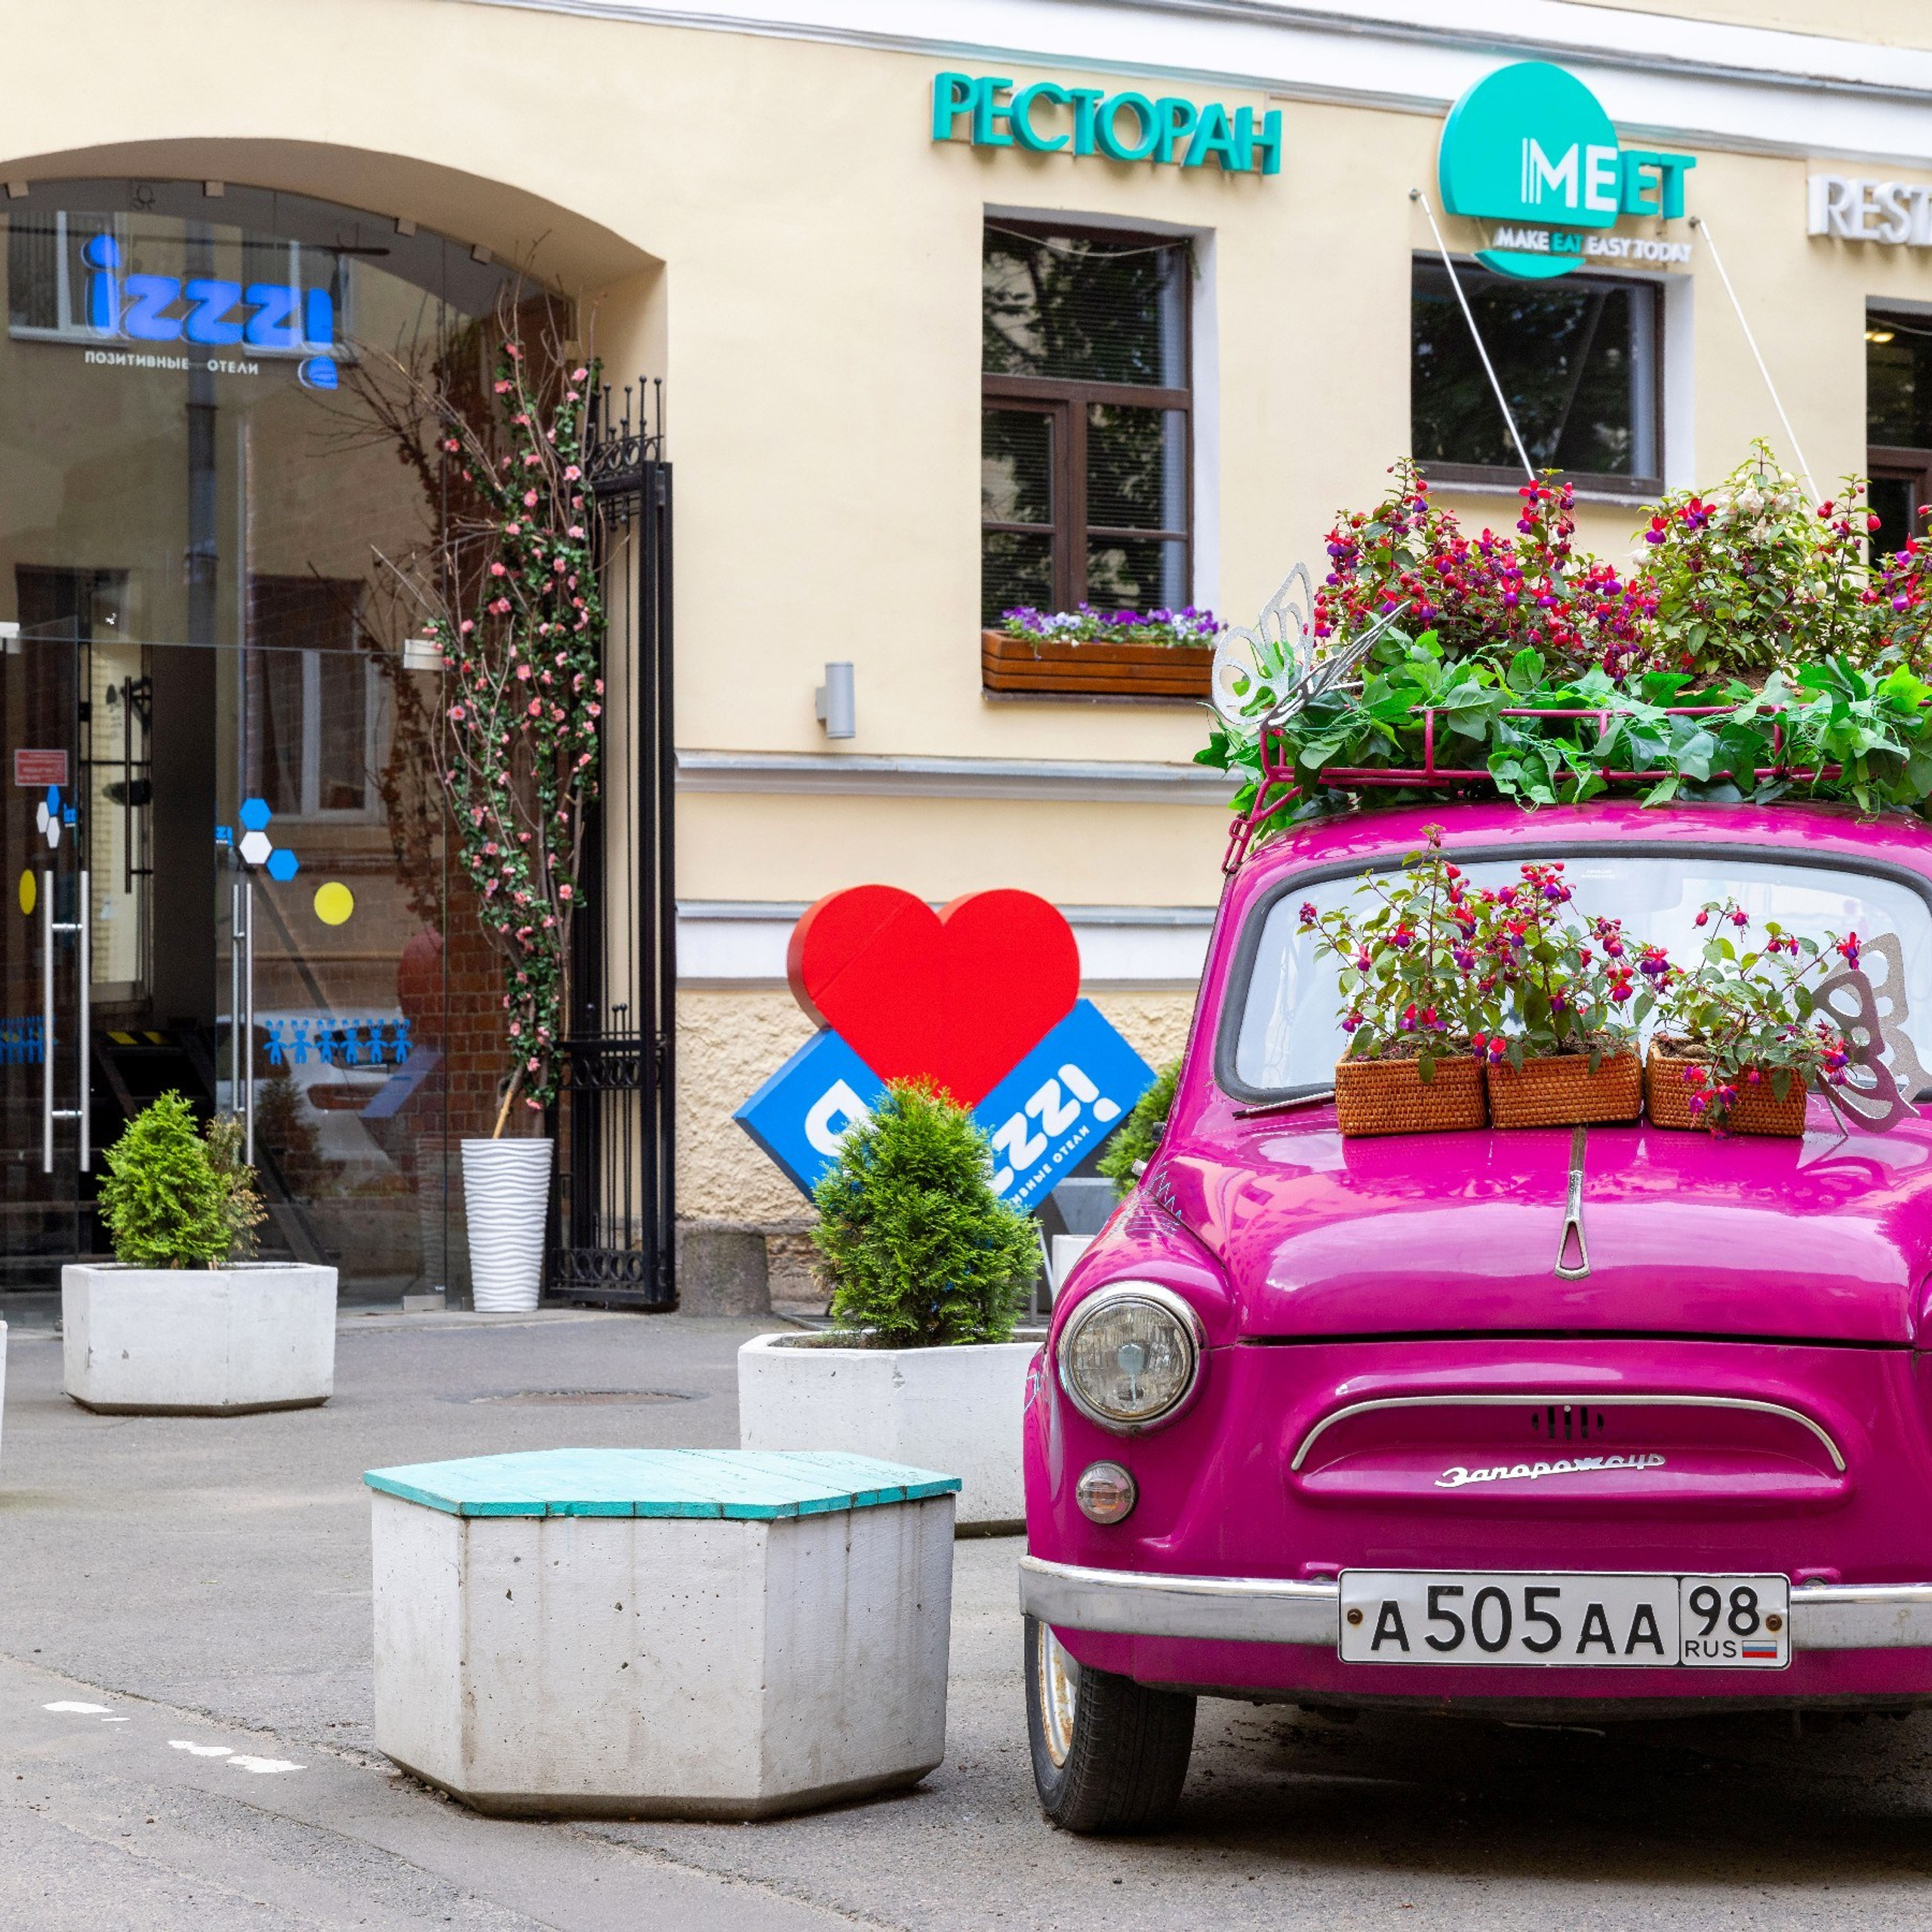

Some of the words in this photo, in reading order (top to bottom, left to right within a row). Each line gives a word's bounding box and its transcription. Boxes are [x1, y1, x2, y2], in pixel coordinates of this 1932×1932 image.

[932, 72, 1282, 175] РЕСТОРАН
[1521, 137, 1697, 220] MEET
[1494, 226, 1549, 251] MAKE
[1549, 231, 1583, 254] EAT
[1586, 235, 1632, 258] EASY
[1630, 241, 1693, 263] TODAY
[85, 351, 189, 370] ПОЗИТИВНЫЕ
[207, 359, 259, 375] ОТЕЛИ
[1052, 1124, 1091, 1164] ОТЕЛИ
[1689, 1586, 1760, 1636] 98
[1684, 1640, 1737, 1658] RUS
